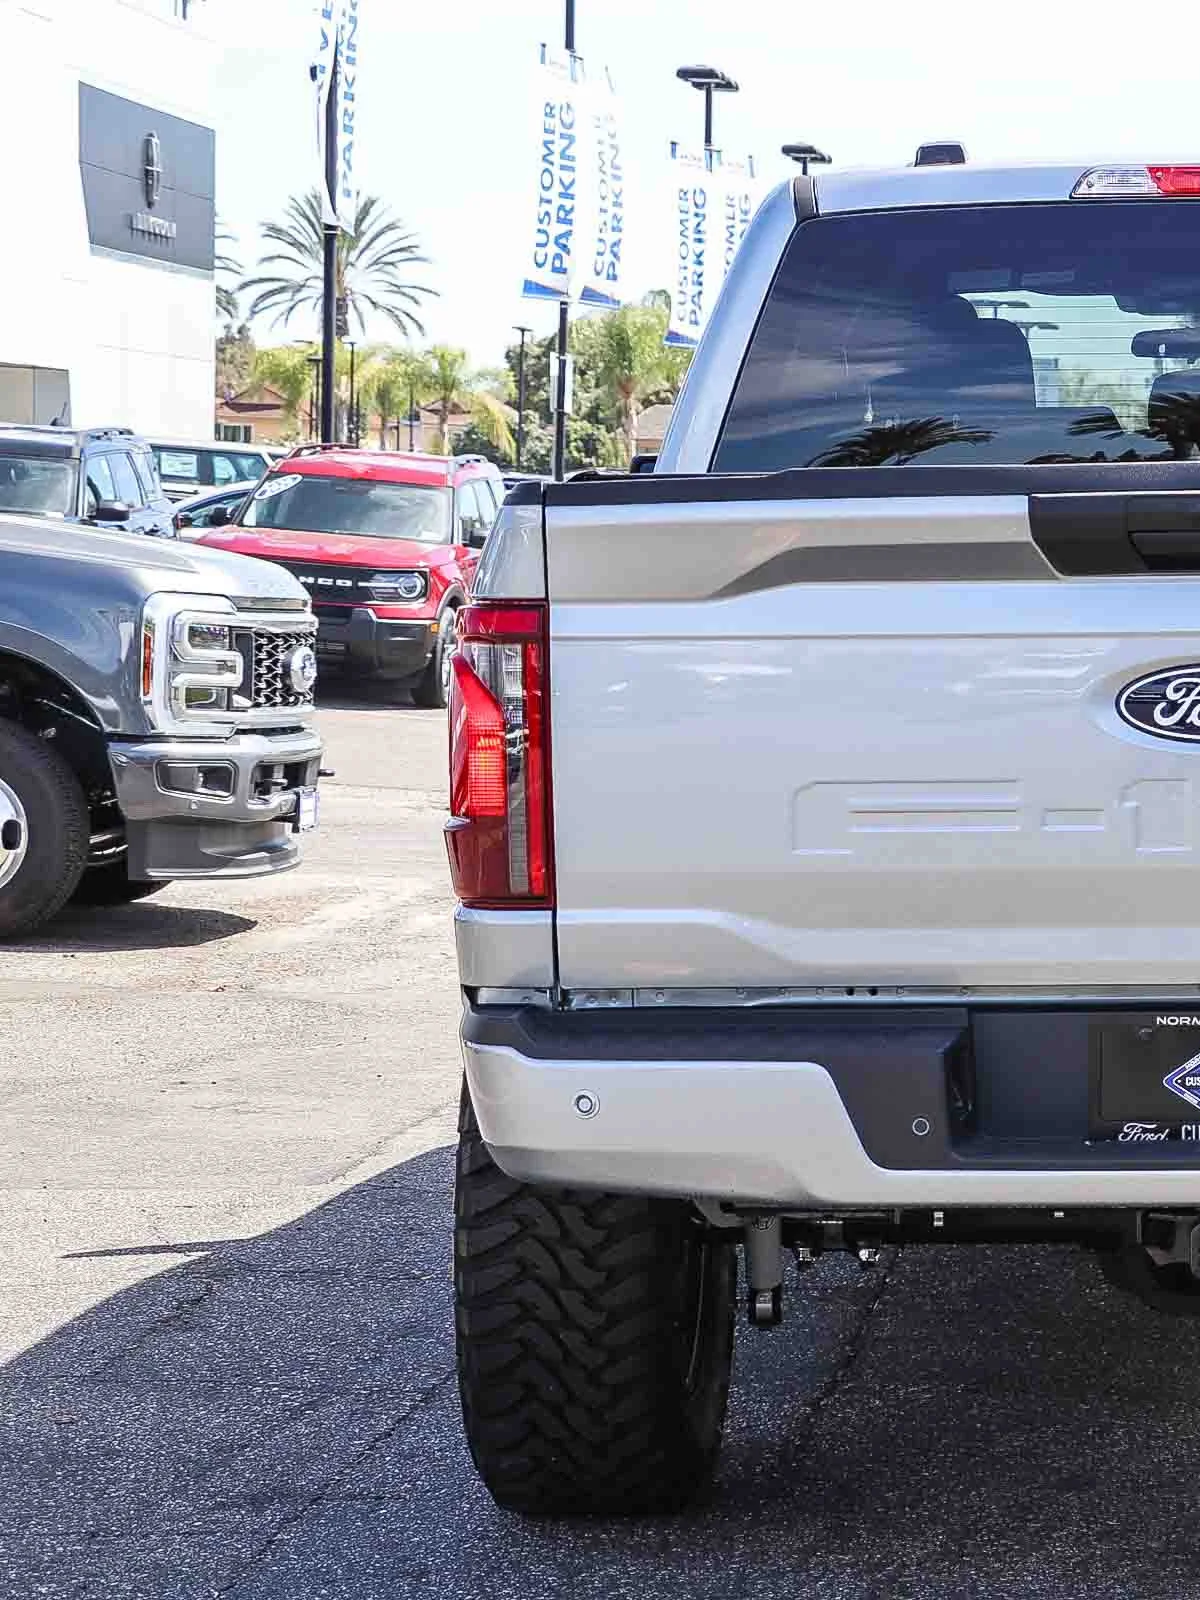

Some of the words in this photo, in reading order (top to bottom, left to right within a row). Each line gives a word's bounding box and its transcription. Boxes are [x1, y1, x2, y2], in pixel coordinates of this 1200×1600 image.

[534, 102, 557, 269] CUSTOMER
[551, 102, 576, 274] PARKING
[689, 188, 707, 326] PARKING
[299, 576, 353, 587] NCO
